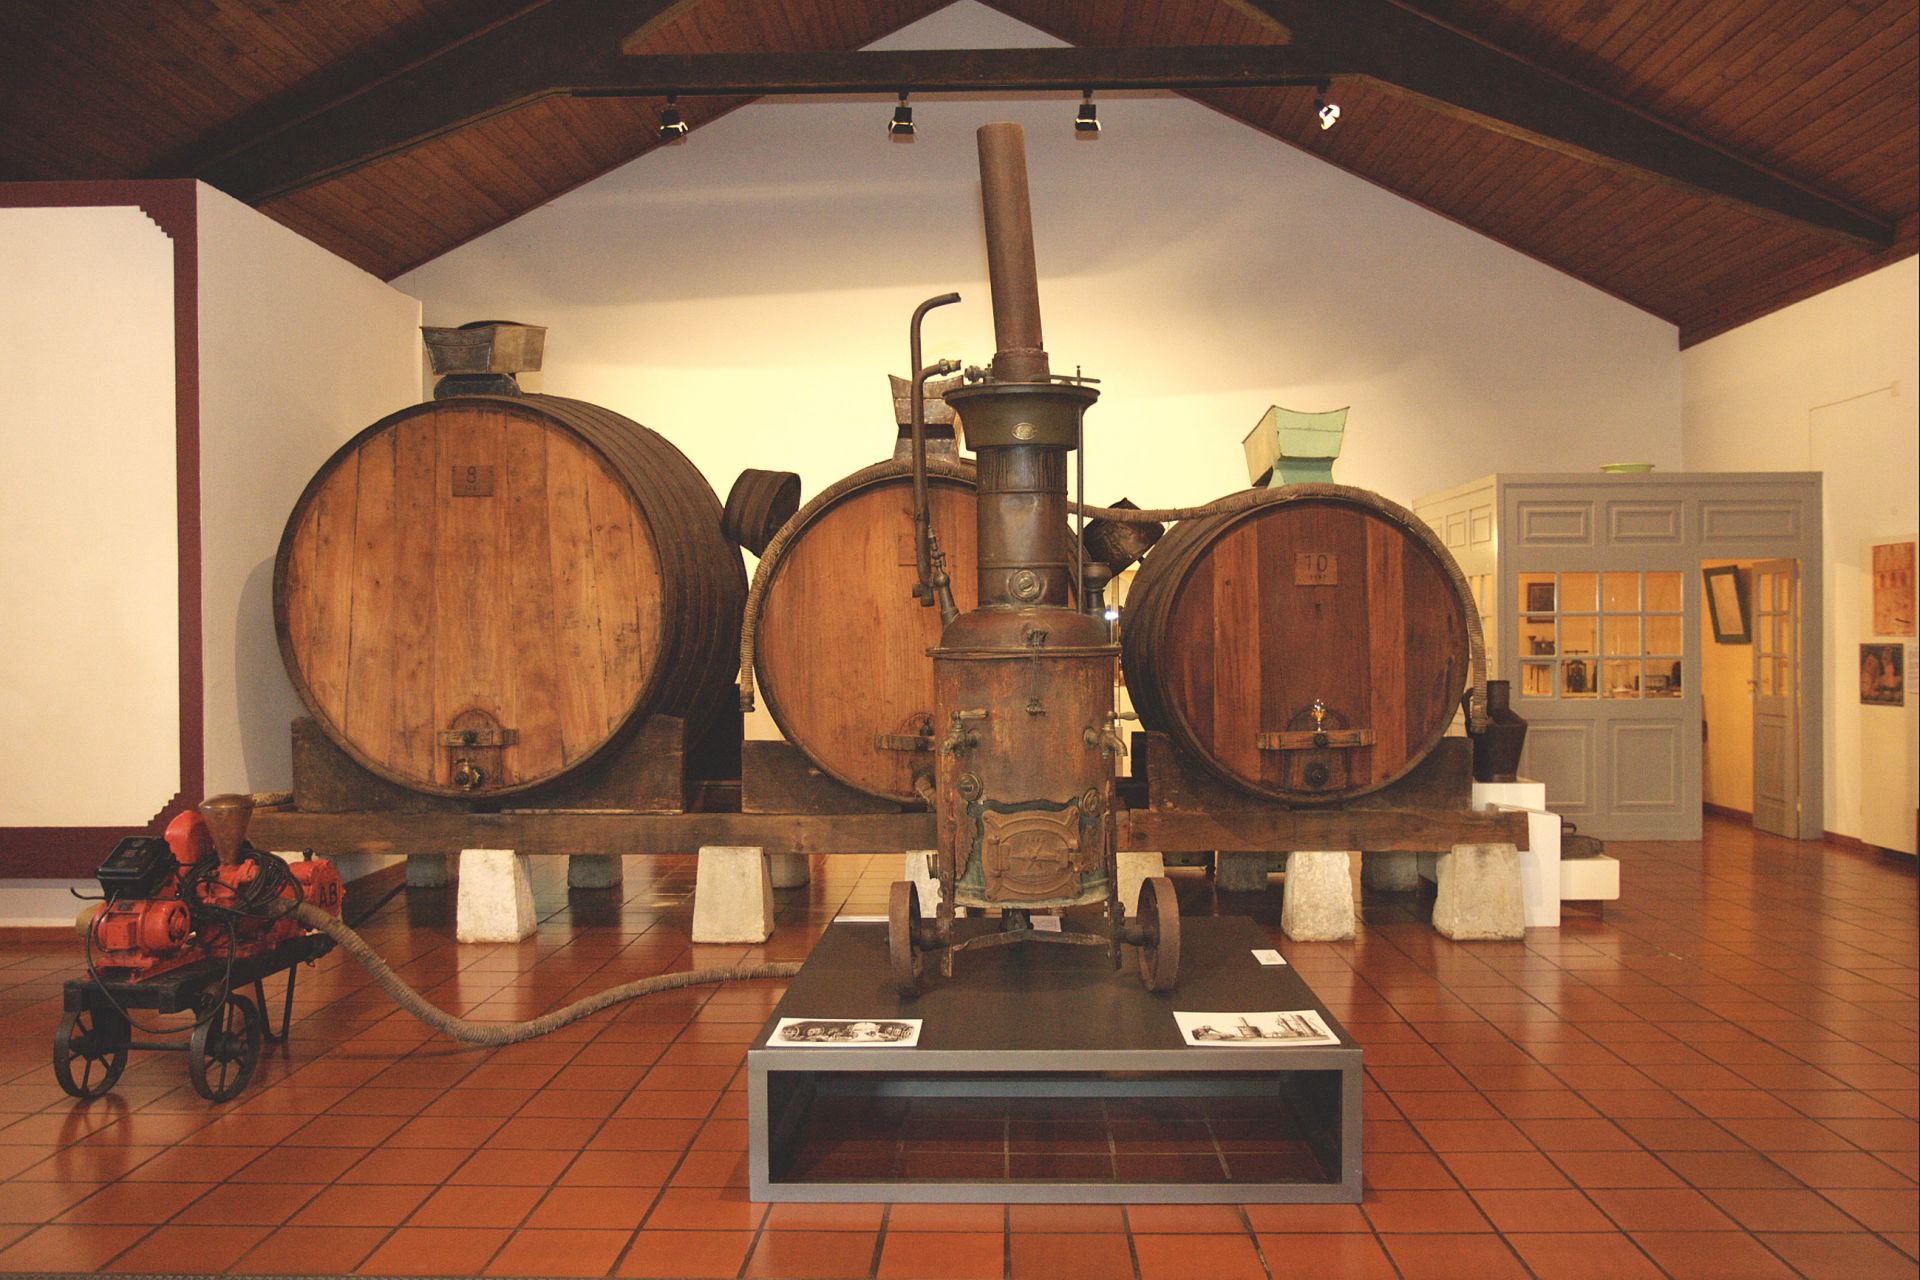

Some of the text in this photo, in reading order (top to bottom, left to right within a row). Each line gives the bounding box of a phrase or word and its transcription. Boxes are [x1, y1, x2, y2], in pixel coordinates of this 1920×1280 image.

[466, 466, 477, 483] 8
[1304, 554, 1328, 573] 10
[319, 882, 337, 908] AB
